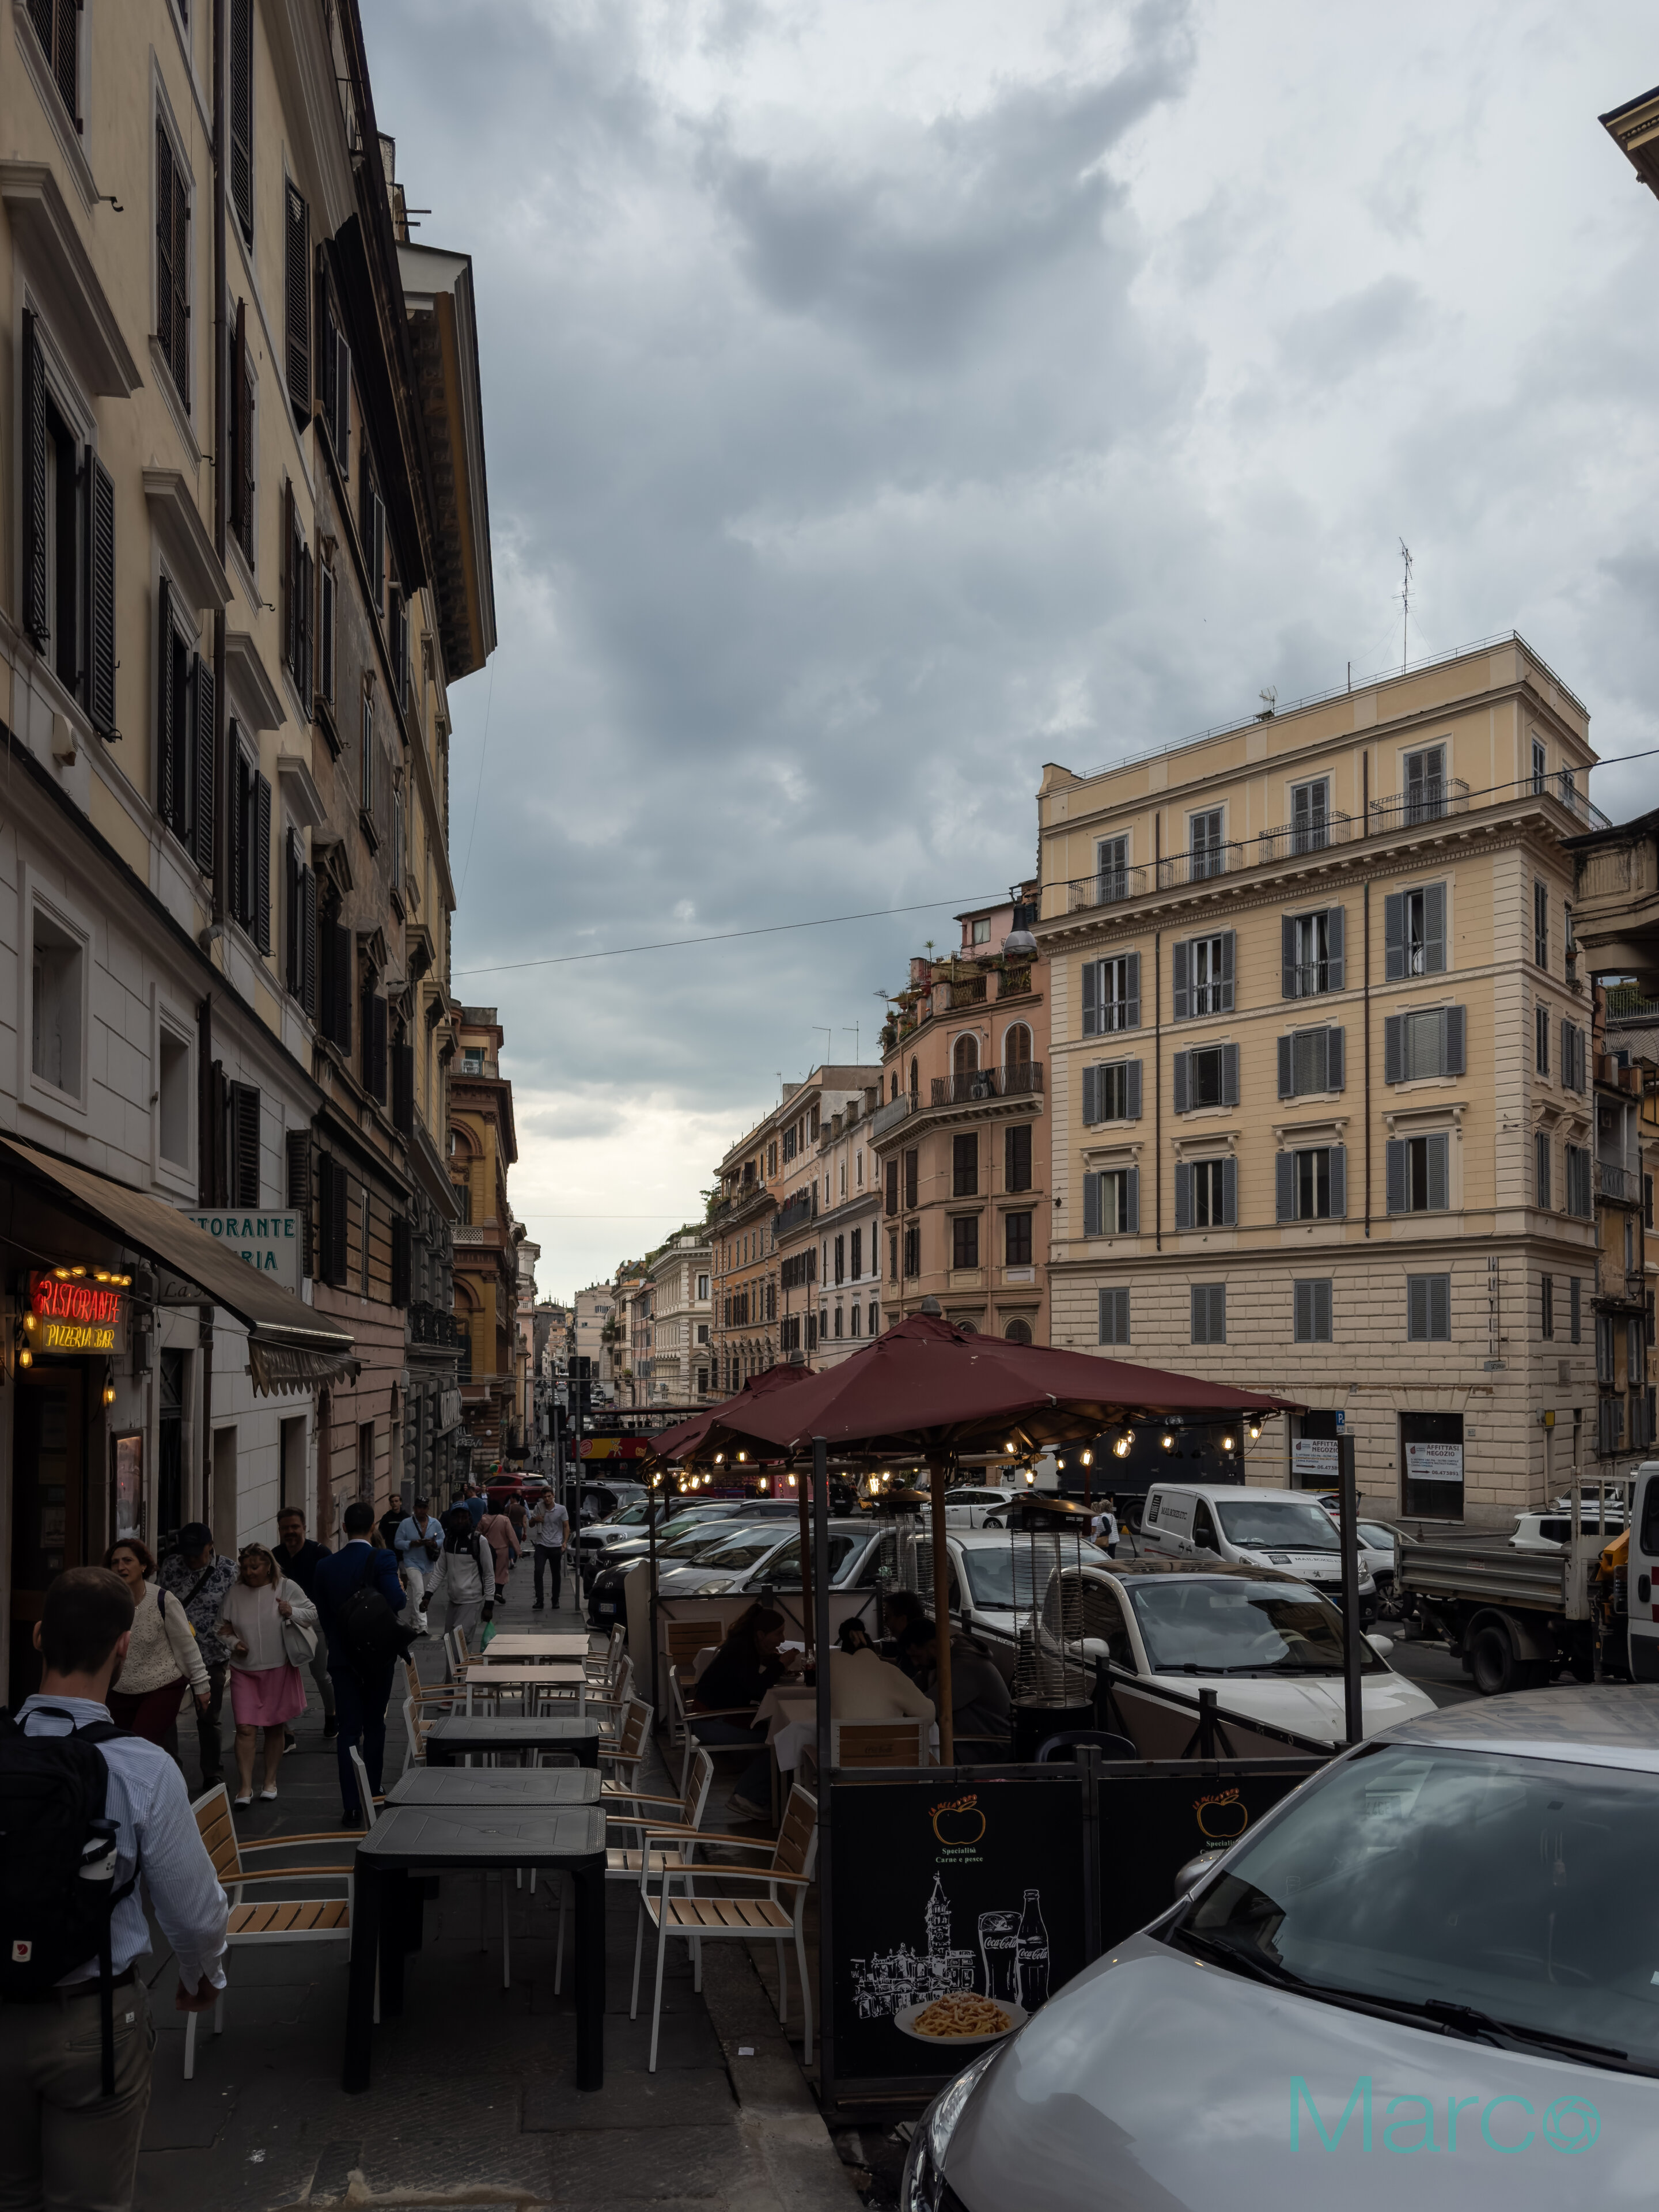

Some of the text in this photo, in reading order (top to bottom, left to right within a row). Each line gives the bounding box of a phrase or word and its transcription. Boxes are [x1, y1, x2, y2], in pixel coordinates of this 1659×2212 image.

[189, 1218, 296, 1238] TORANTE
[234, 1251, 278, 1271] RIA
[39, 1280, 122, 1323] RISTORANTE
[46, 1324, 115, 1349] PIZZERIA BAR
[456, 1426, 467, 1435] RIA
[937, 1801, 956, 1810] MELA
